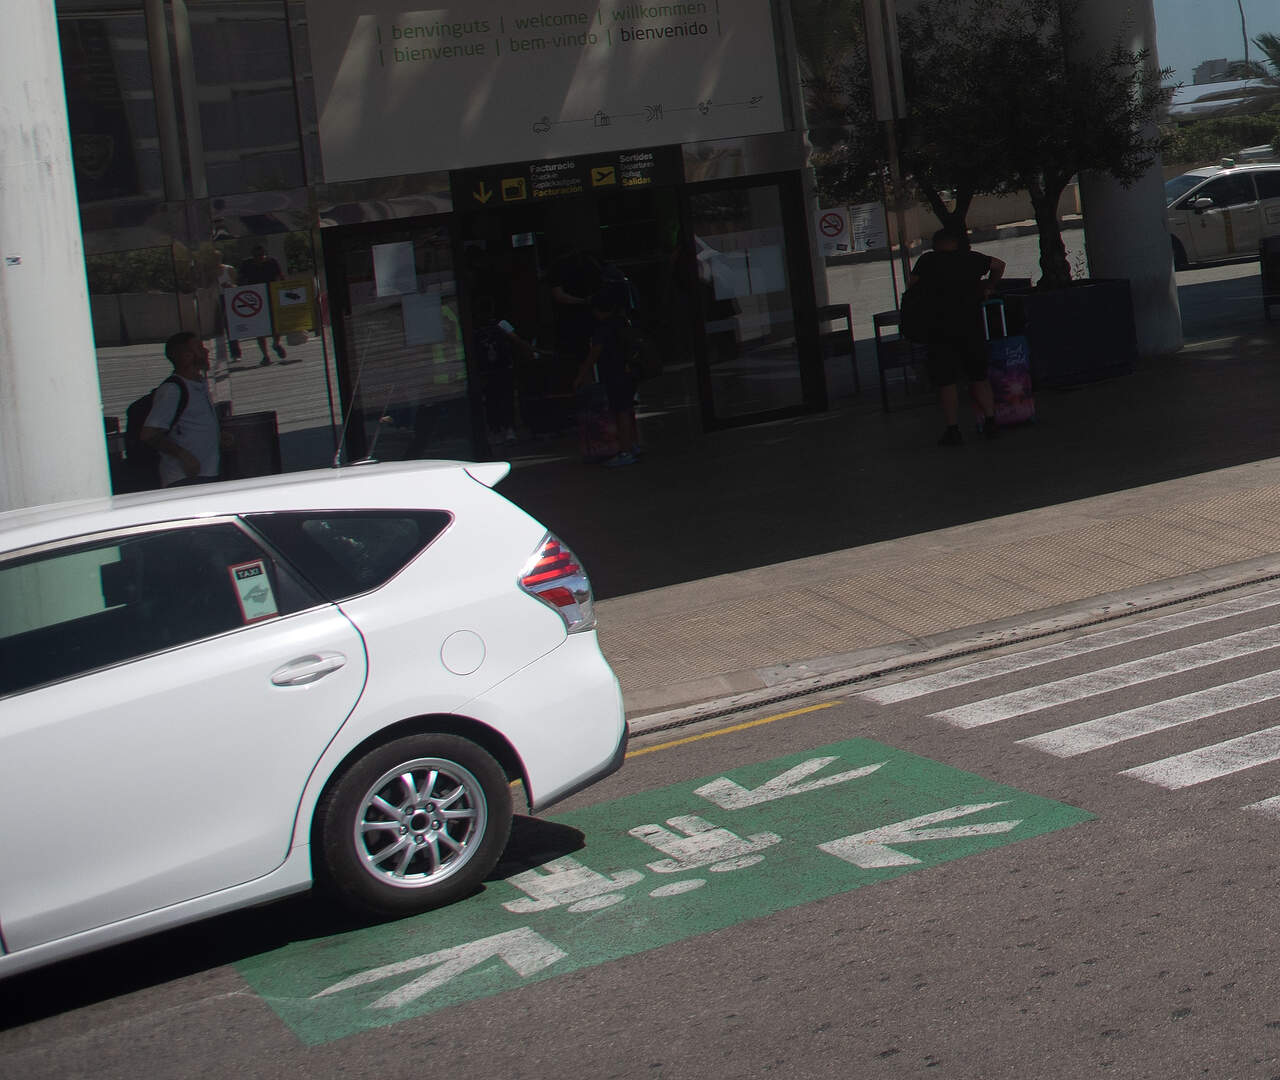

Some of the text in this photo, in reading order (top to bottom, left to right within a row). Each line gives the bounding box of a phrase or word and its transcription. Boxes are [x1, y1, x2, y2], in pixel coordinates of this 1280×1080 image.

[391, 0, 707, 41] benvinguts welcome willkommen
[394, 21, 709, 63] bienvenue bem-vindo bienvenido
